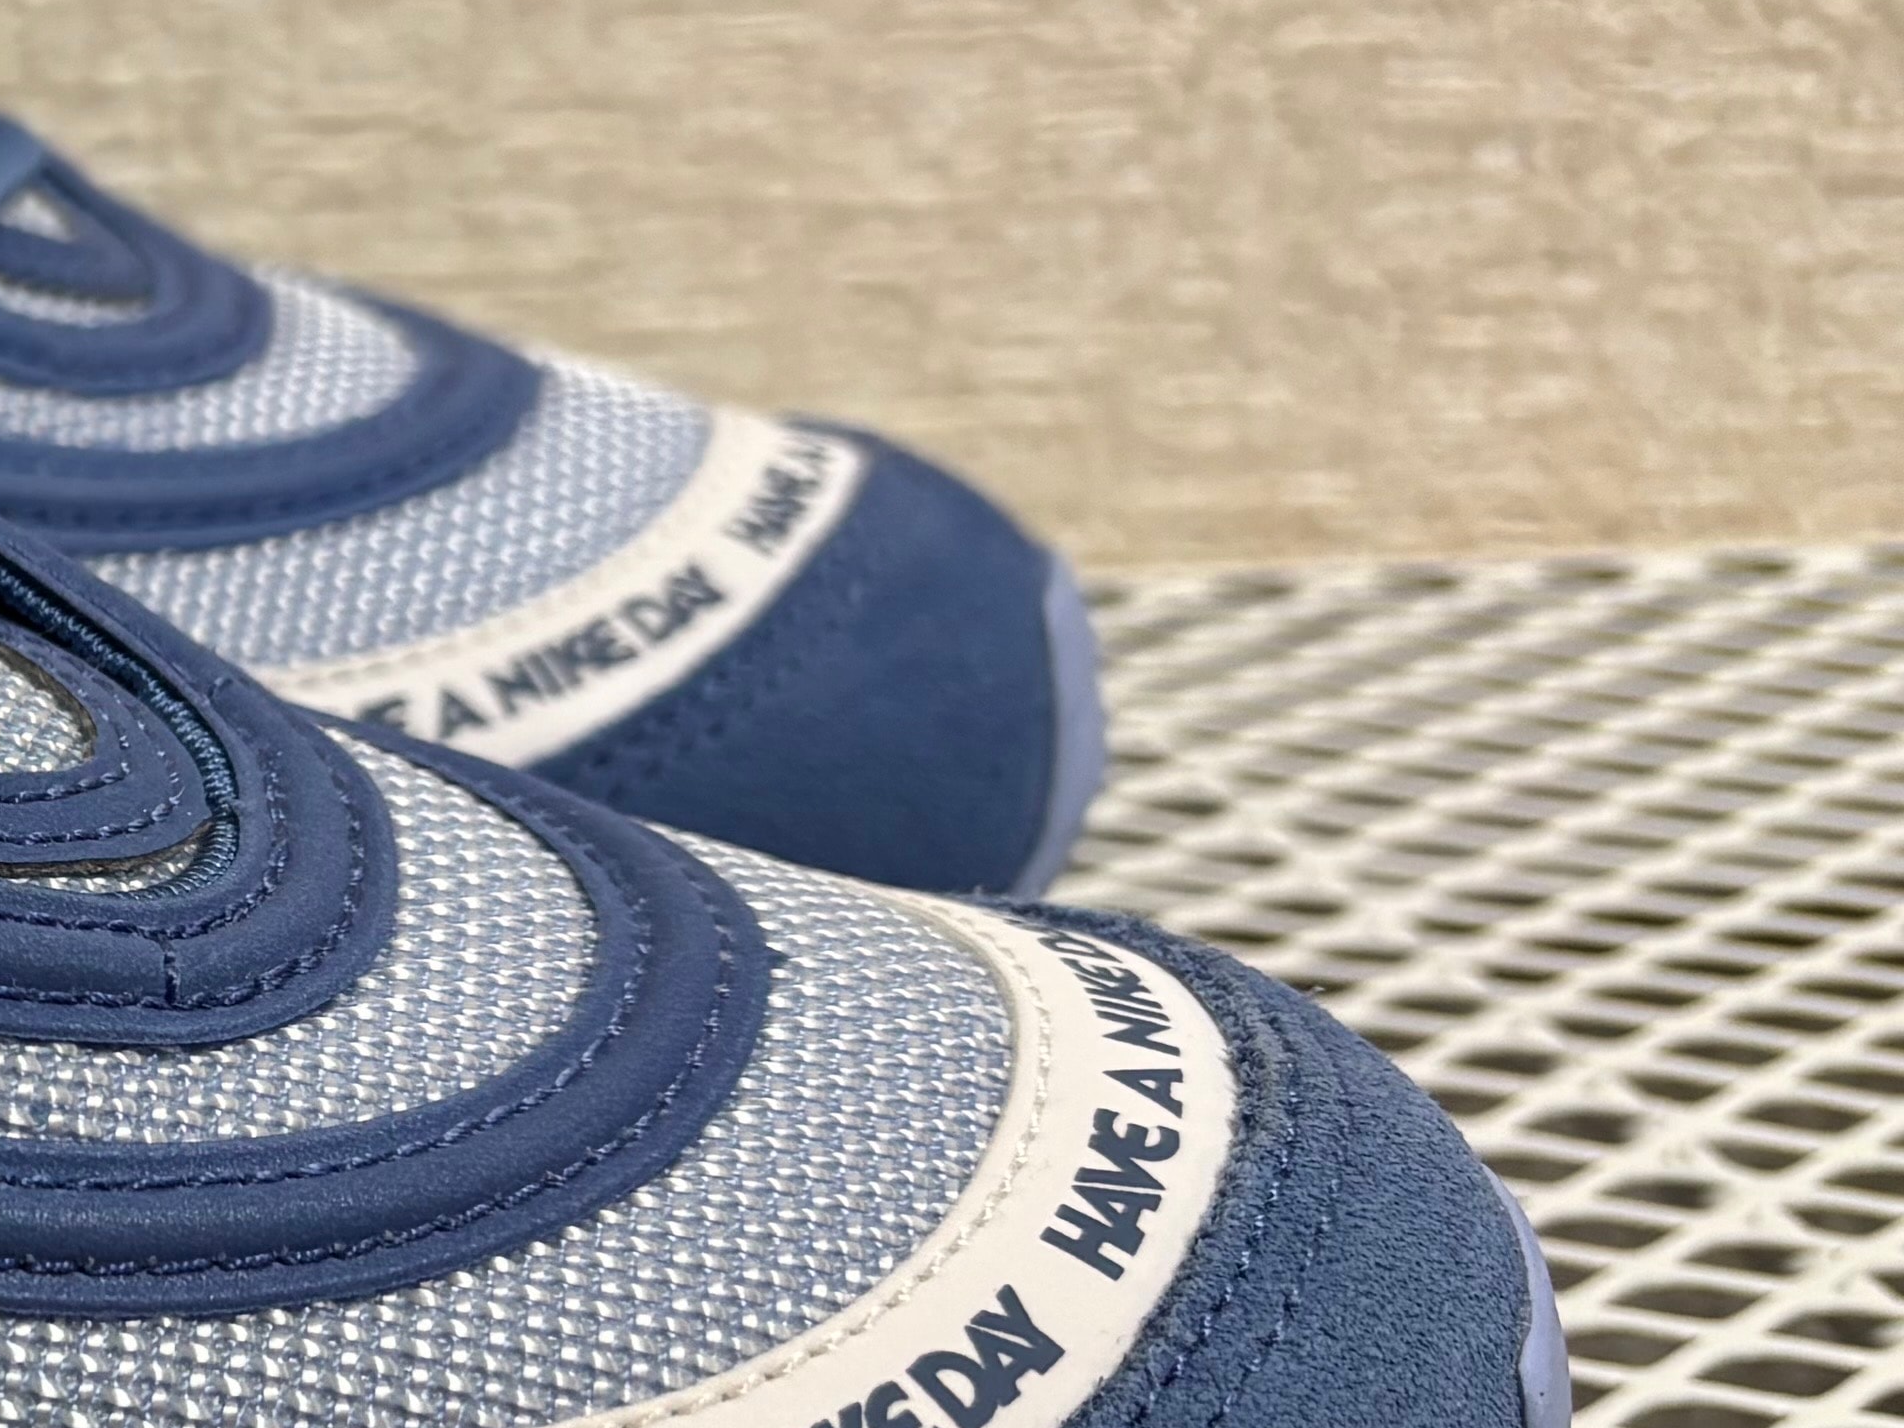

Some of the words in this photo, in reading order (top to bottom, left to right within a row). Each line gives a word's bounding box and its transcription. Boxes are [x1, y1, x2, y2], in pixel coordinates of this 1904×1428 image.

[437, 687, 489, 739] A
[490, 615, 643, 716] NIKE
[618, 561, 727, 646] DAY
[1059, 957, 1181, 1057] NIKE
[1102, 1068, 1184, 1120] A
[1039, 1107, 1181, 1282] HAVE
